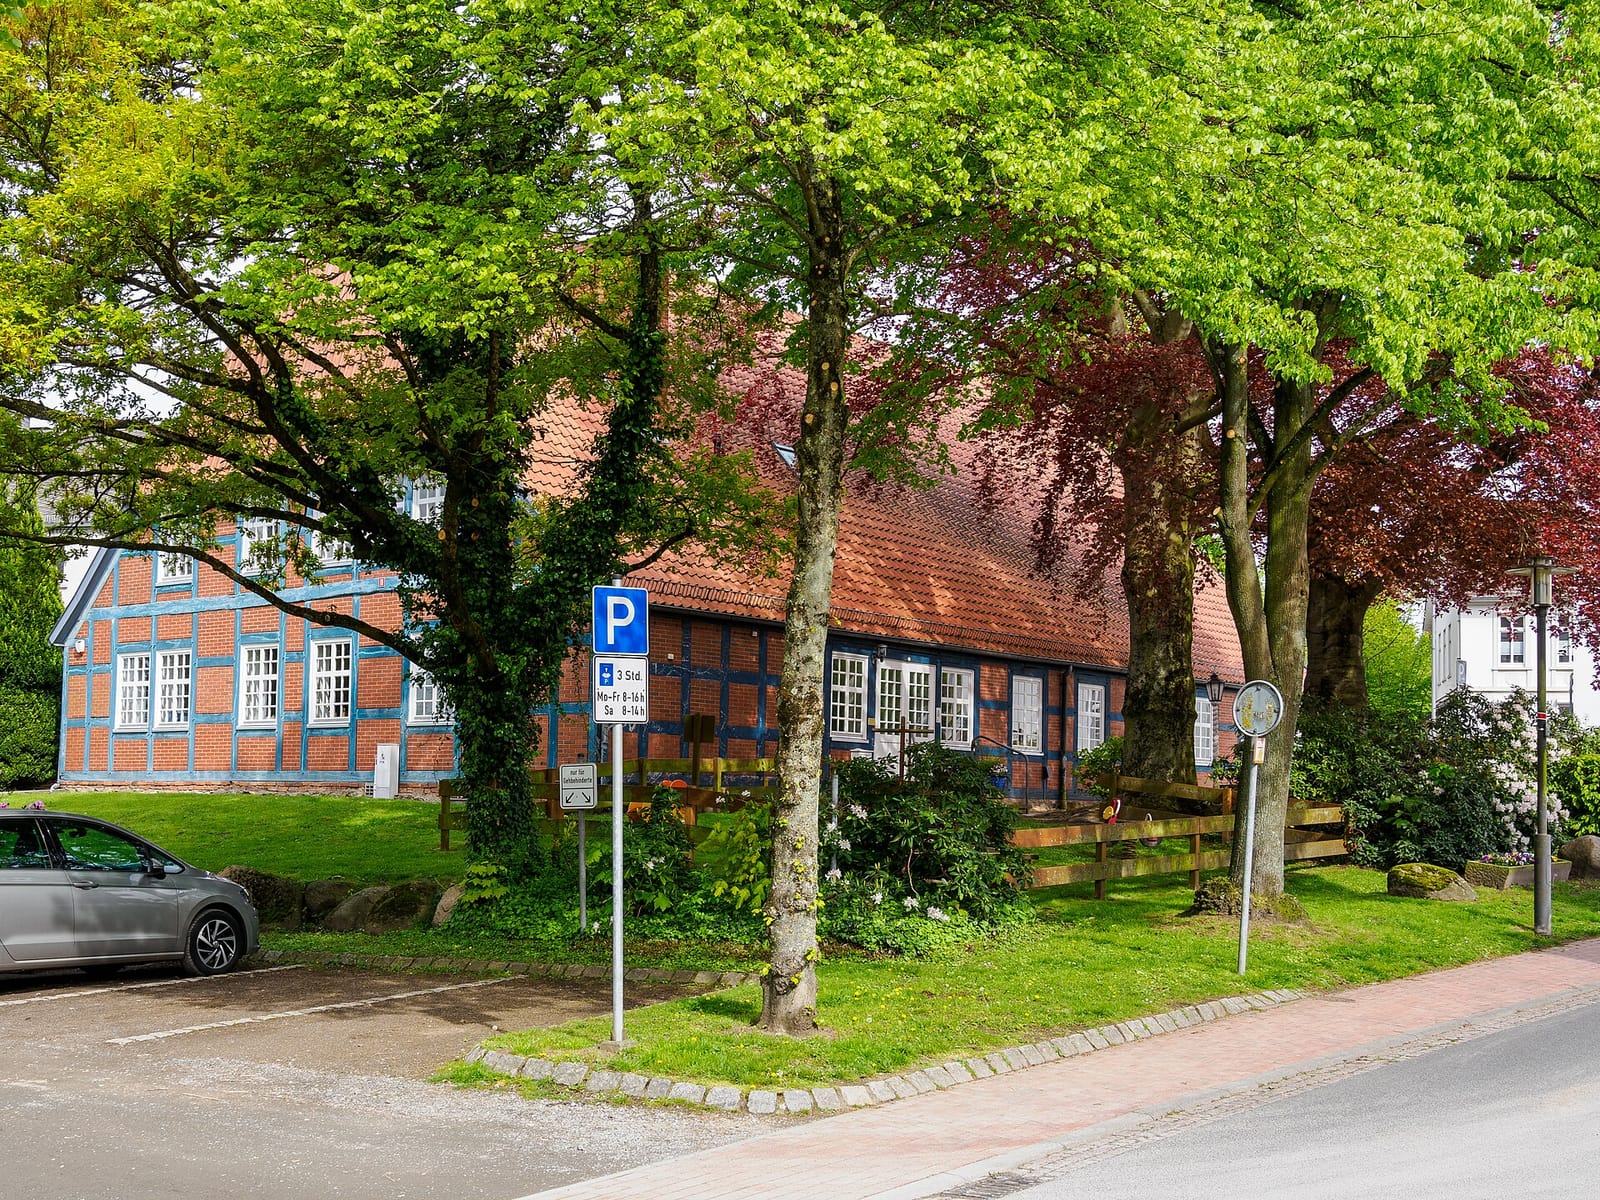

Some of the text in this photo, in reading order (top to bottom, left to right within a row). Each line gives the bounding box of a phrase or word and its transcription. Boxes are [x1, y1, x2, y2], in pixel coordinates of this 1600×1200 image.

[607, 595, 635, 645] P
[617, 670, 643, 681] 3 Std.
[597, 691, 645, 702] Mo-Fr 8-16 h
[604, 704, 645, 716] Sa 8-14 h
